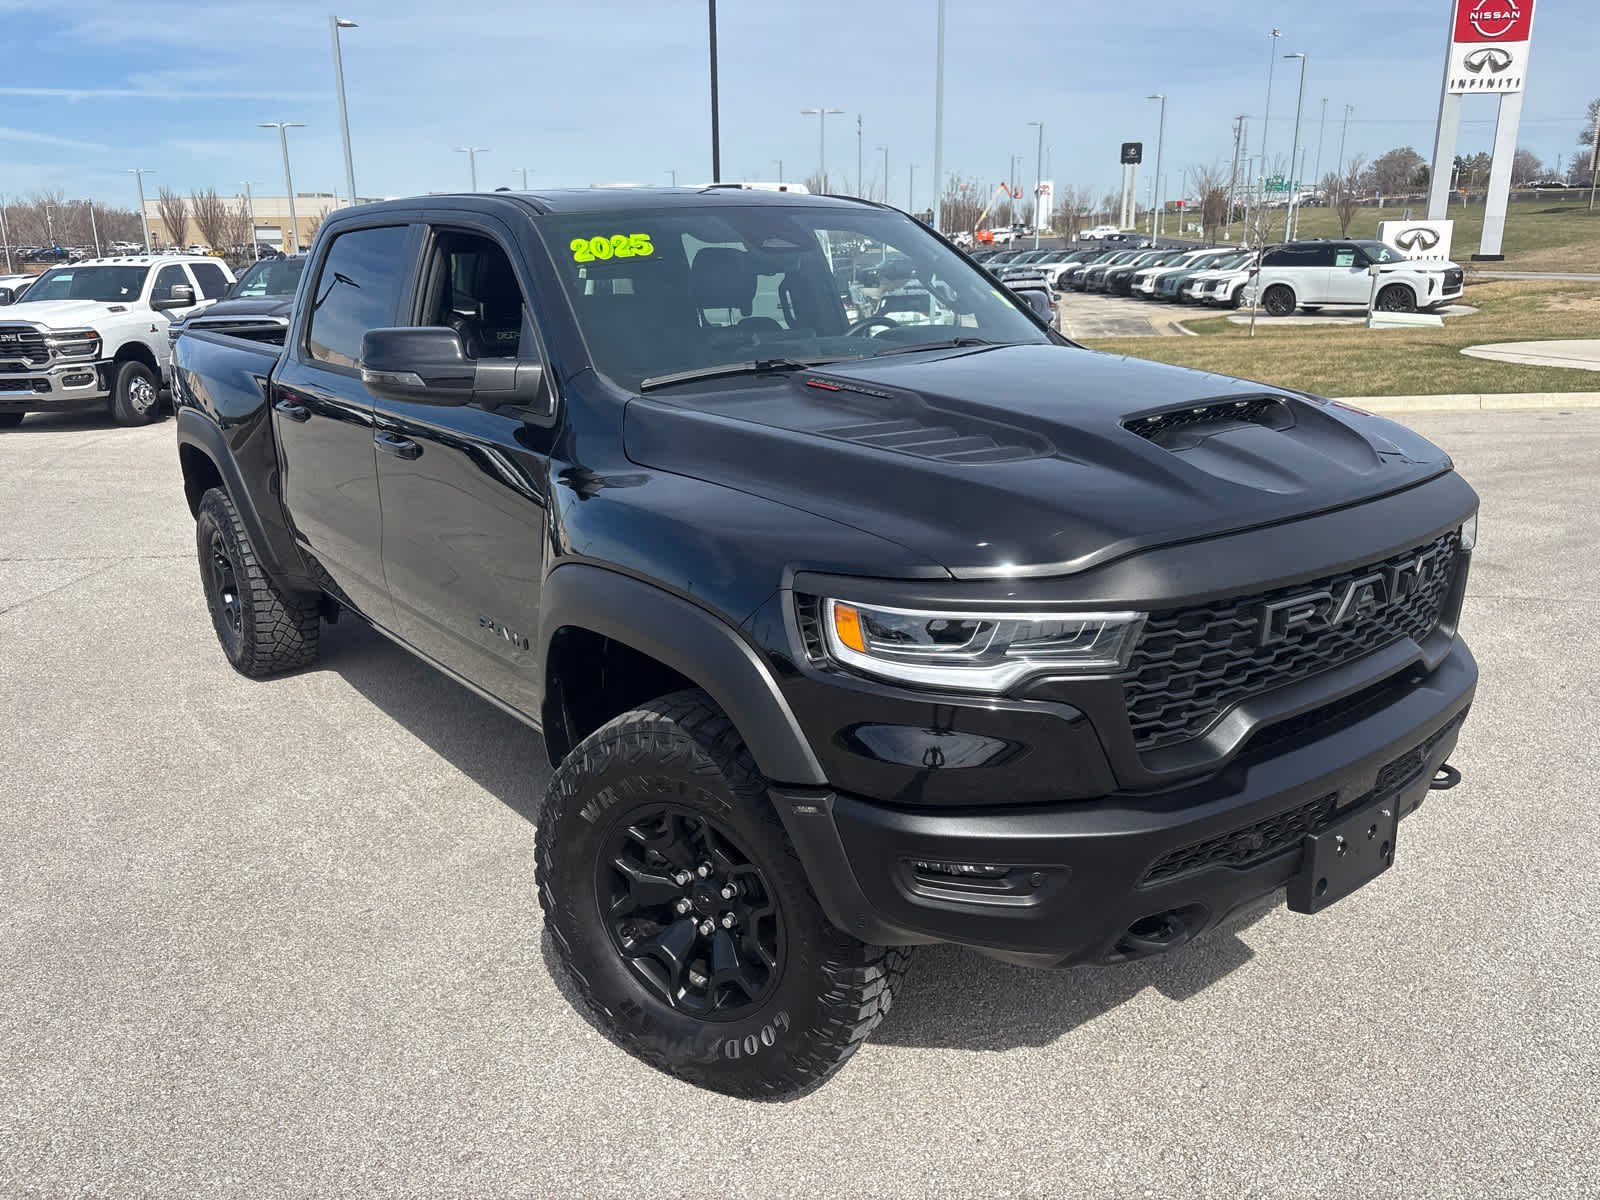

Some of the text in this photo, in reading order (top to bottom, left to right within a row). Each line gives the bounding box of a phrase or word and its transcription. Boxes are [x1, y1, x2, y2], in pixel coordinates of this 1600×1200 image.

[1470, 11, 1521, 20] NISSAN
[1450, 77, 1521, 89] INFINITI
[570, 233, 655, 263] 2025
[1262, 553, 1436, 646] RAM
